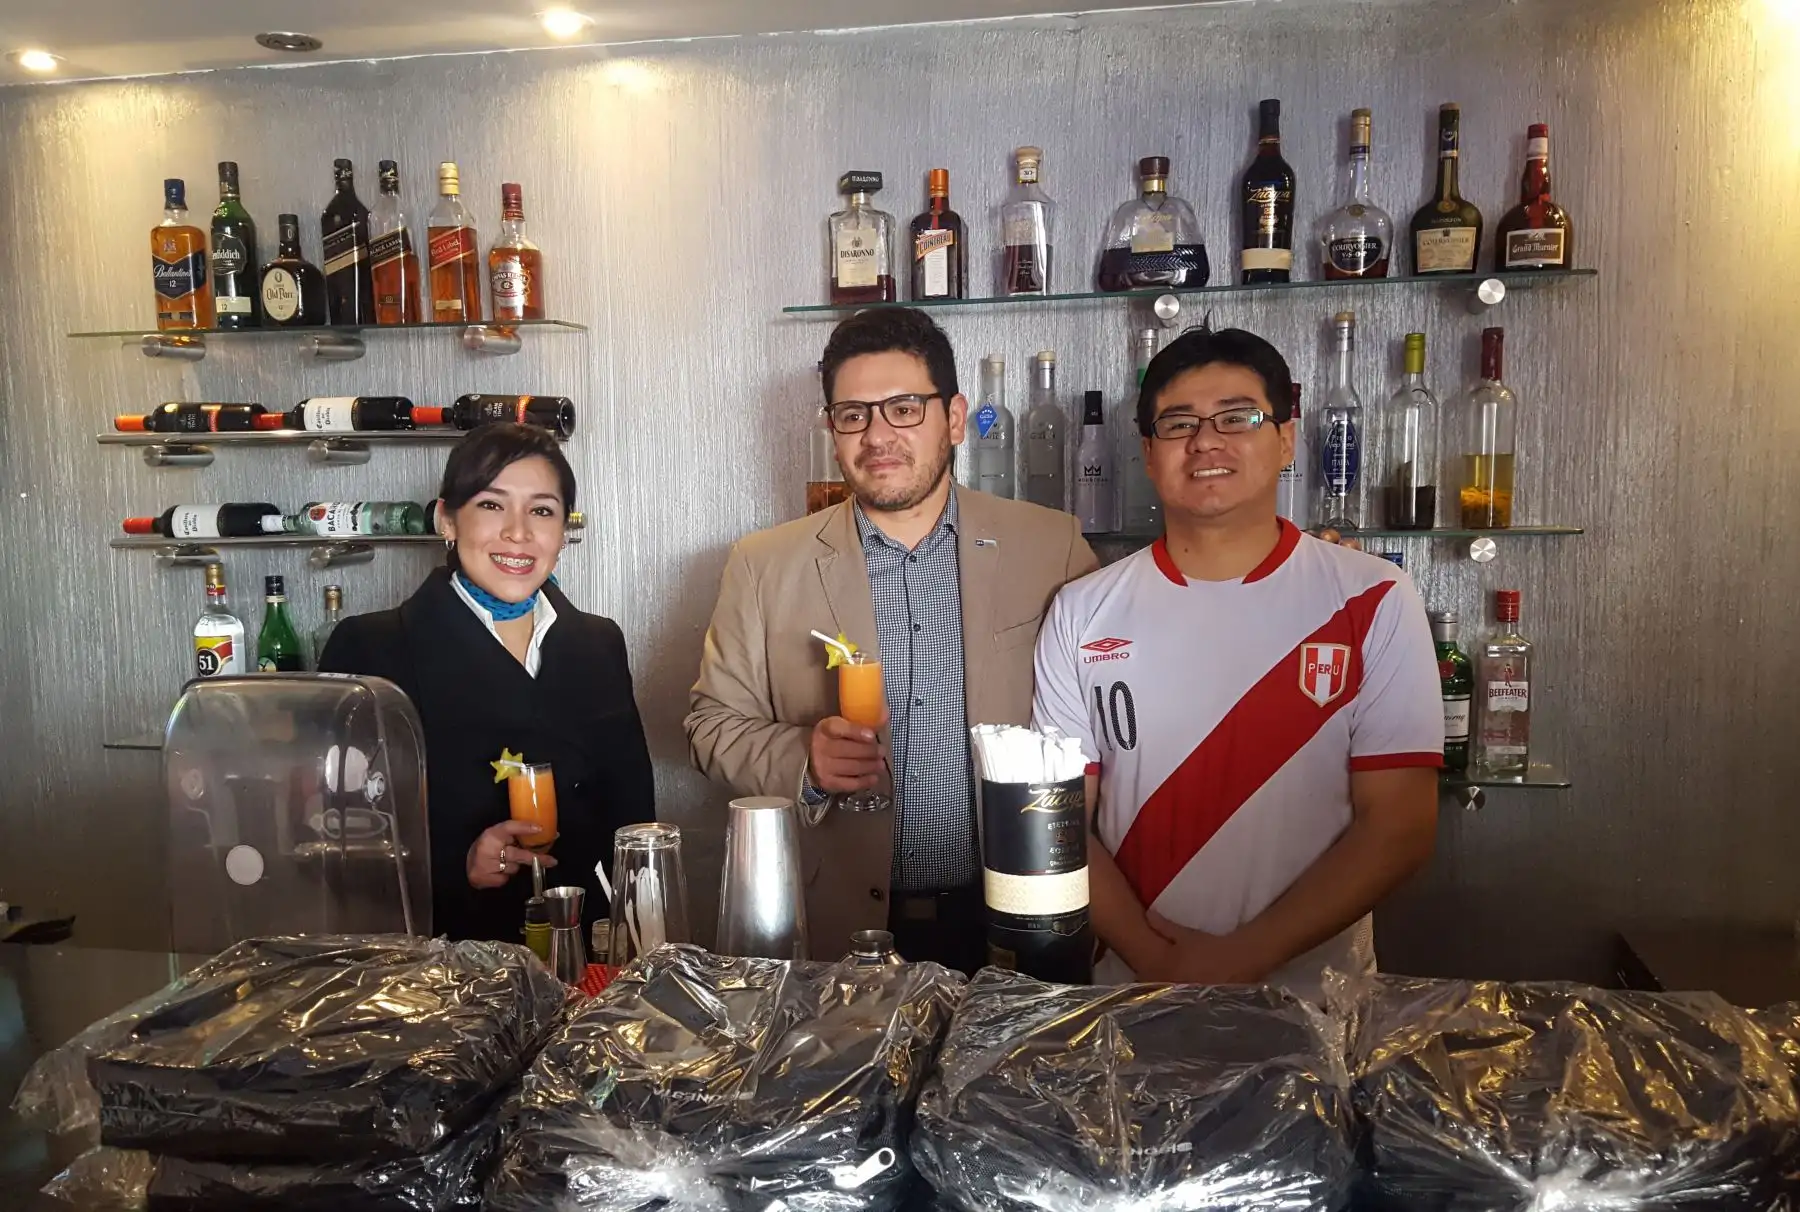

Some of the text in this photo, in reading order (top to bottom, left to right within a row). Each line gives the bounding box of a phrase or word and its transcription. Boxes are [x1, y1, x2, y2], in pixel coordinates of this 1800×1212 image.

[1247, 188, 1291, 203] Zacpa
[840, 248, 875, 259] DISARONNO
[169, 280, 176, 288] 12
[266, 288, 278, 300] Old
[199, 655, 214, 671] 51
[1083, 652, 1130, 664] UMBRO
[1308, 662, 1340, 676] PERU
[1488, 688, 1527, 698] BEEFEATER
[1094, 680, 1137, 751] 10
